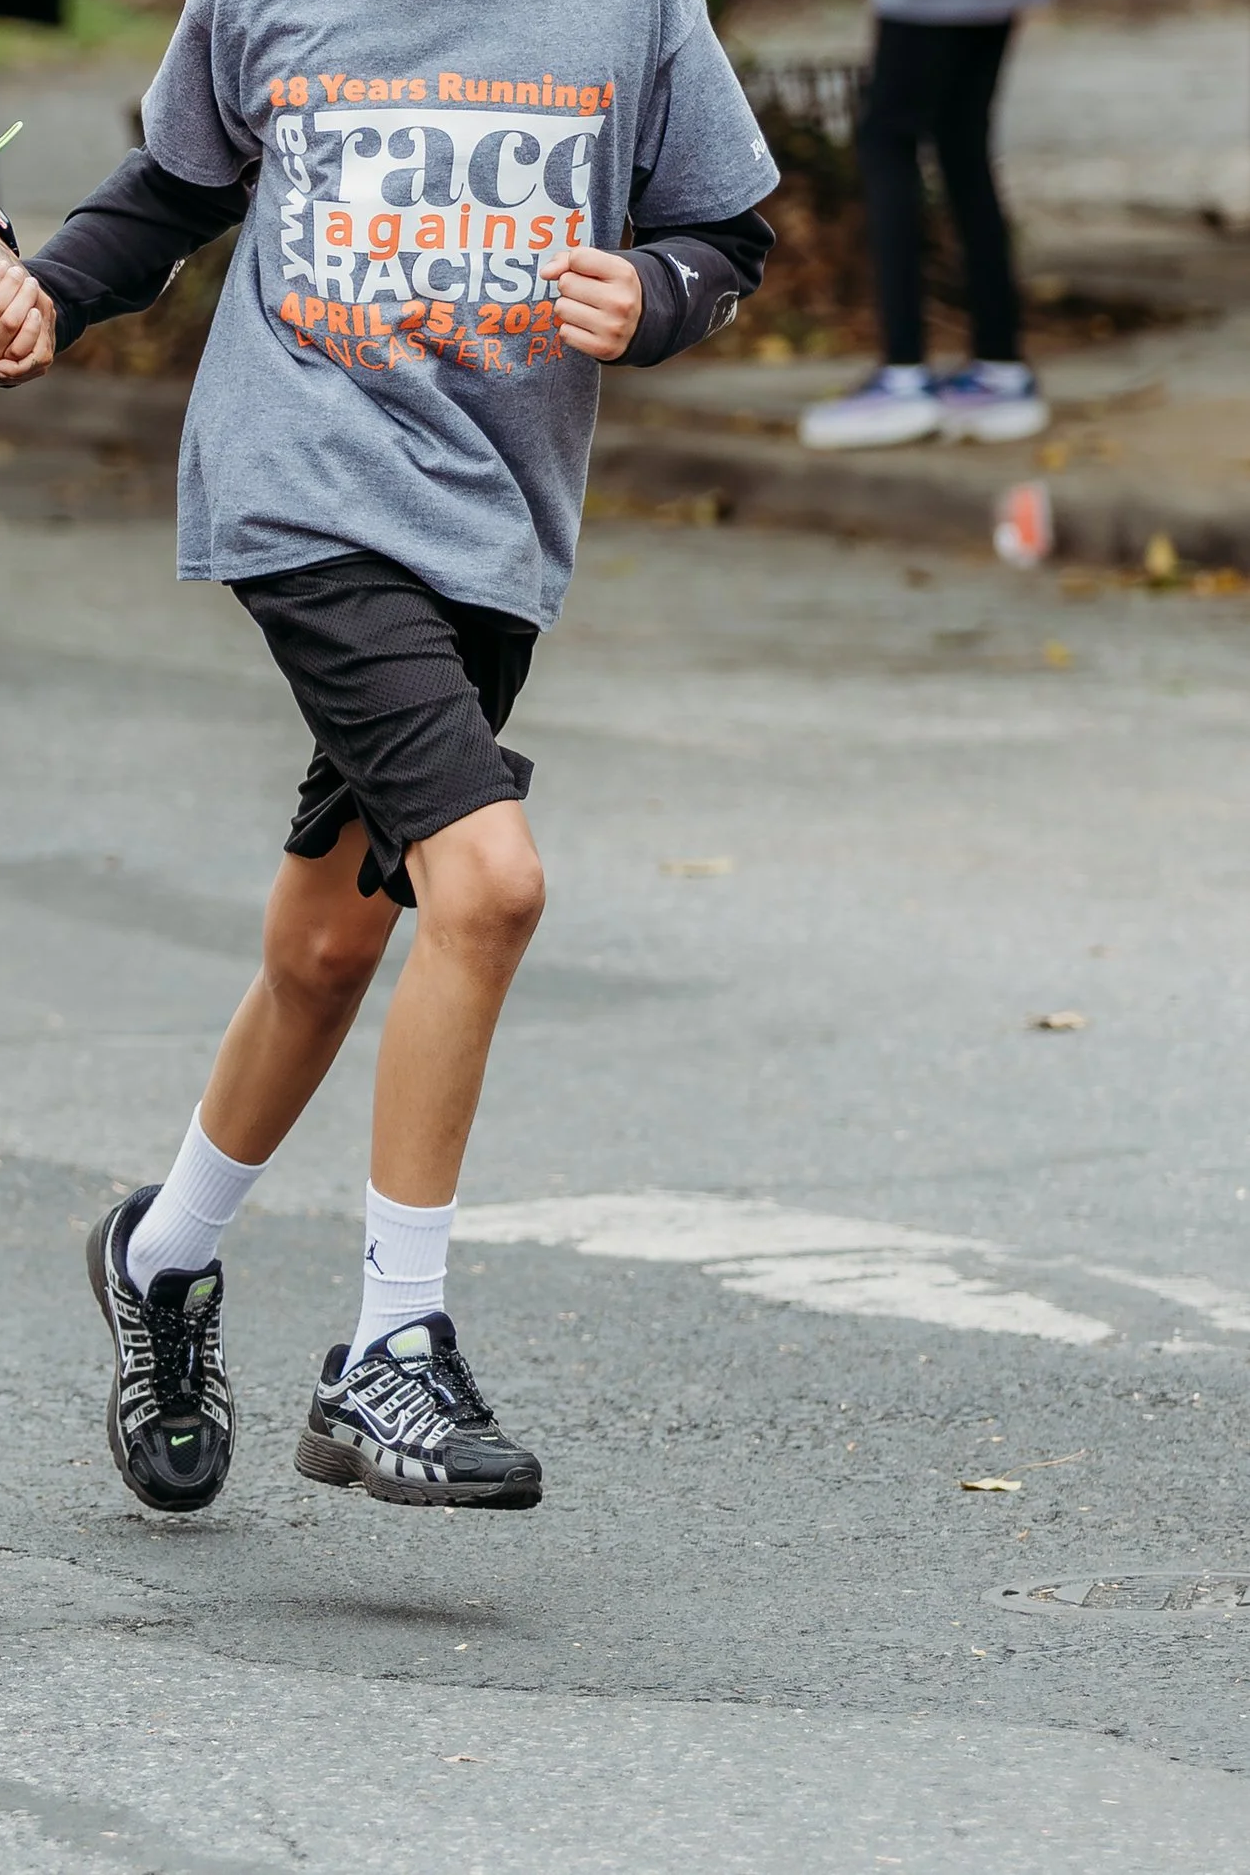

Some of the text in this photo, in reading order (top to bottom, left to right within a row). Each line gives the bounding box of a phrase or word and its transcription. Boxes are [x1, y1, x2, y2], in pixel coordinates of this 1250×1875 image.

[269, 72, 614, 116] 28 Years Running!
[314, 125, 598, 209] race
[276, 114, 318, 285] ywca
[326, 203, 586, 261] against
[280, 291, 392, 337] APRIL
[398, 299, 467, 341] 25,
[526, 333, 564, 367] PA
